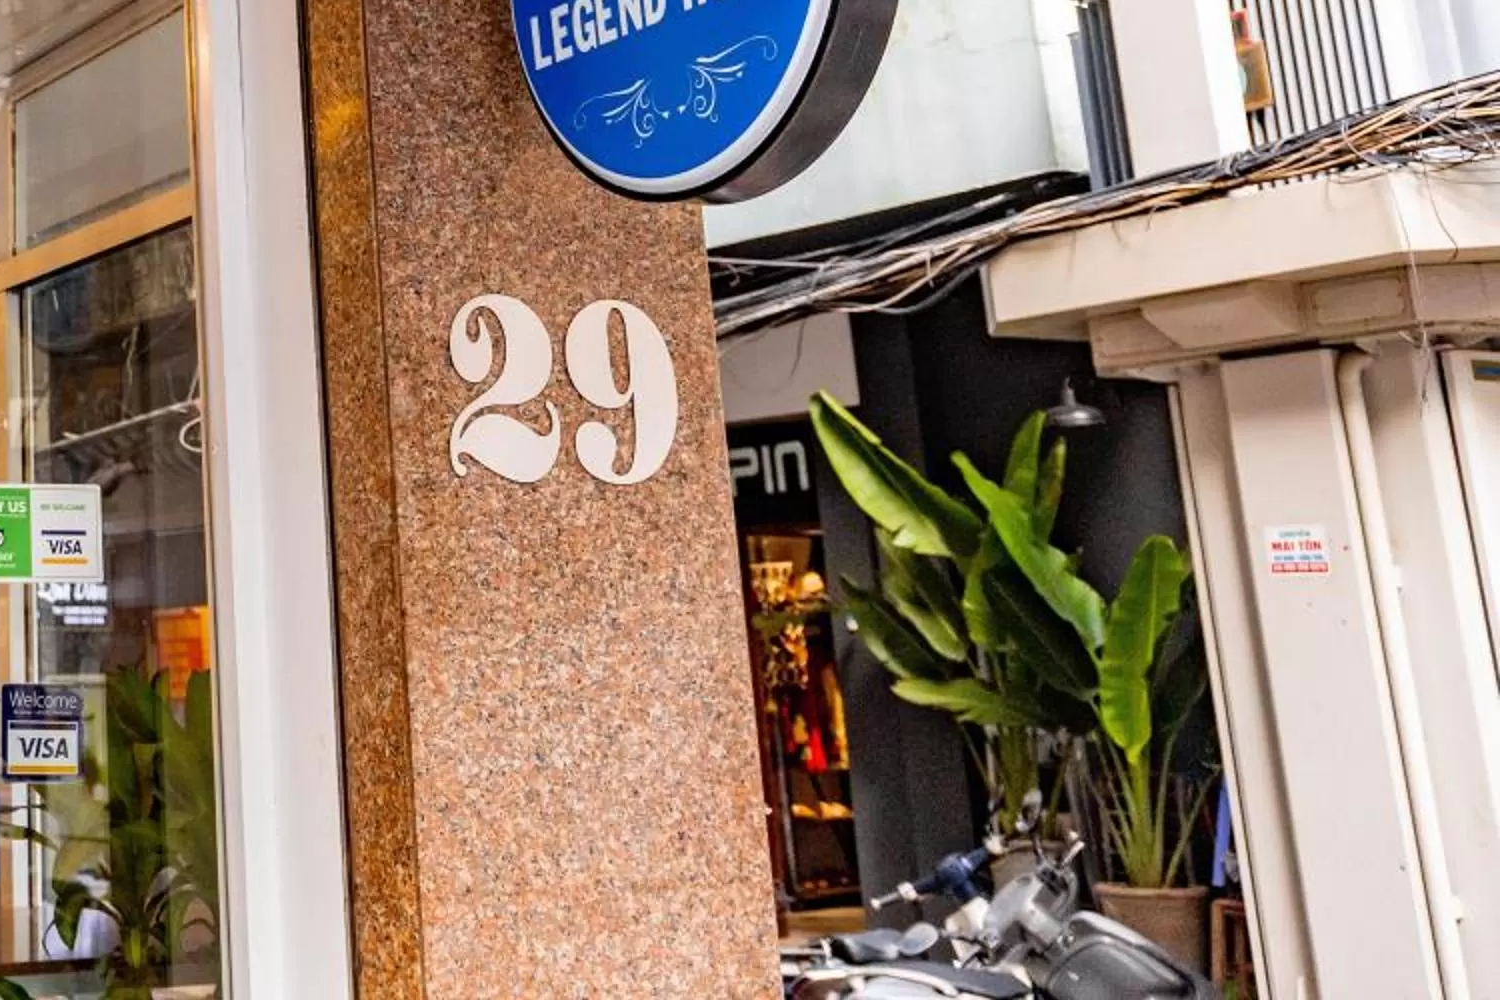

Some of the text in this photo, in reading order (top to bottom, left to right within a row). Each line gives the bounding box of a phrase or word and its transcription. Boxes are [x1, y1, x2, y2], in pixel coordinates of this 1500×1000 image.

[449, 294, 679, 485] 29
[8, 501, 27, 515] US
[48, 538, 83, 556] VISA
[9, 690, 78, 709] Welcome
[19, 737, 70, 759] VISA
